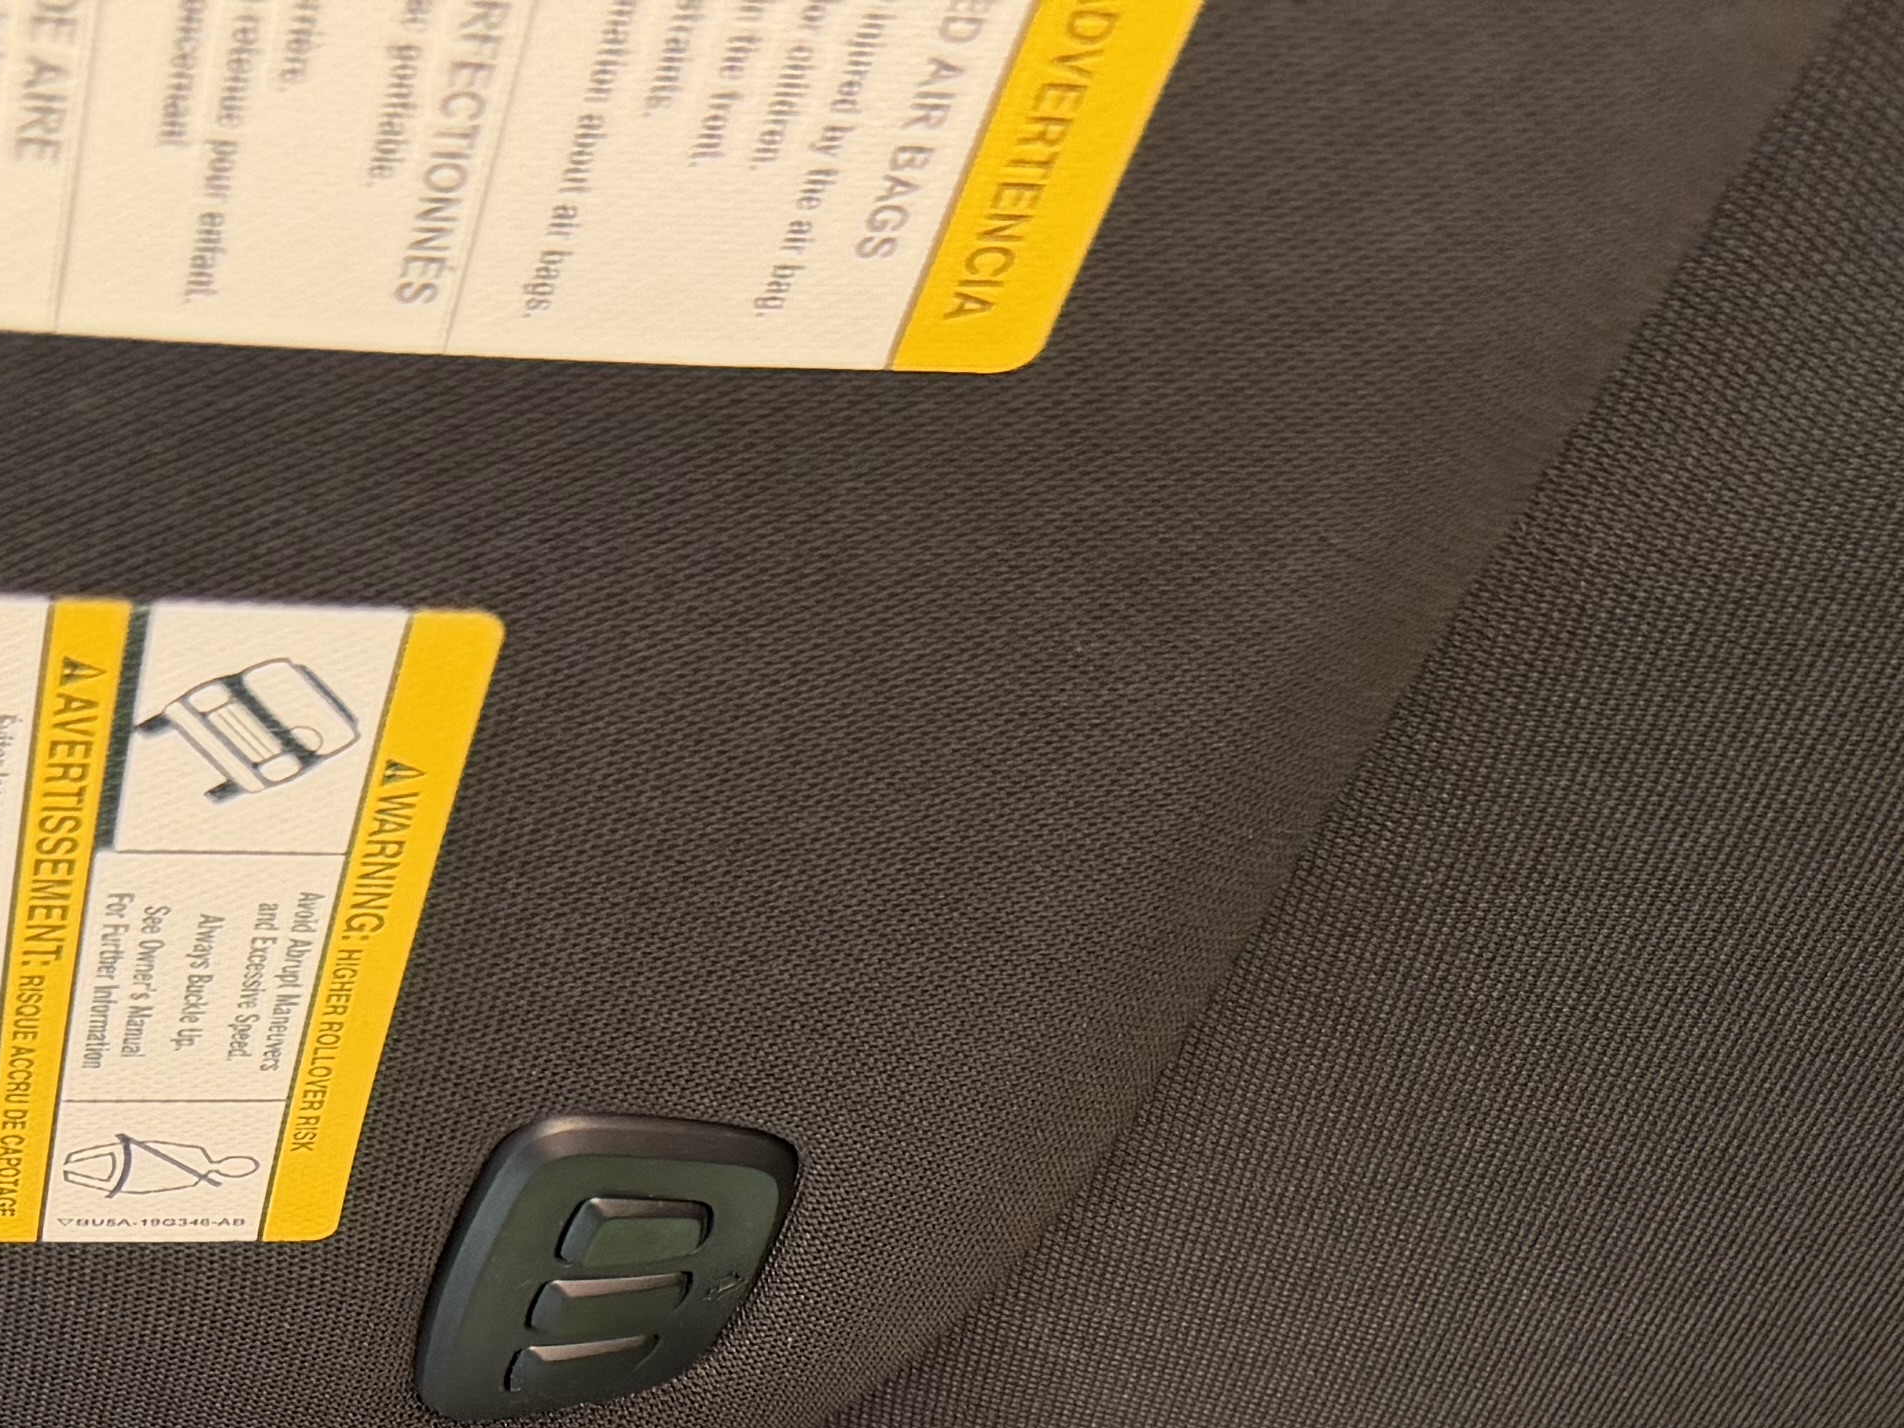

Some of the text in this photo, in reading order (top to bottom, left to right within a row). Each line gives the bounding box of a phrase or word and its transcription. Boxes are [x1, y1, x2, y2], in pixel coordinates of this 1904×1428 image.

[15, 56, 75, 162] AIRE
[900, 57, 966, 130] AIR
[558, 114, 610, 194] about
[796, 169, 840, 210] the
[941, 0, 1122, 322] DVERTENCIA
[546, 205, 582, 240] air
[780, 220, 816, 254] air
[855, 146, 936, 259] BAGS
[522, 250, 575, 318] bags.
[753, 265, 806, 317] bag.
[21, 693, 100, 966] AVERTISSEMENT:
[12, 975, 45, 1040] RISQUE
[82, 893, 135, 1069] For Further Information
[120, 906, 171, 1057] See Owner's Manual
[171, 914, 226, 1051] Always Buckle Up.
[227, 903, 280, 1061] and Excessive Speed.
[260, 892, 326, 1071] Avoid Abrupt Maneuvers
[291, 792, 421, 1152] WARNING: HIGHER ROLLOVER RISK
[3, 1110, 27, 1130] DE
[4, 1046, 36, 1104] ACCRU
